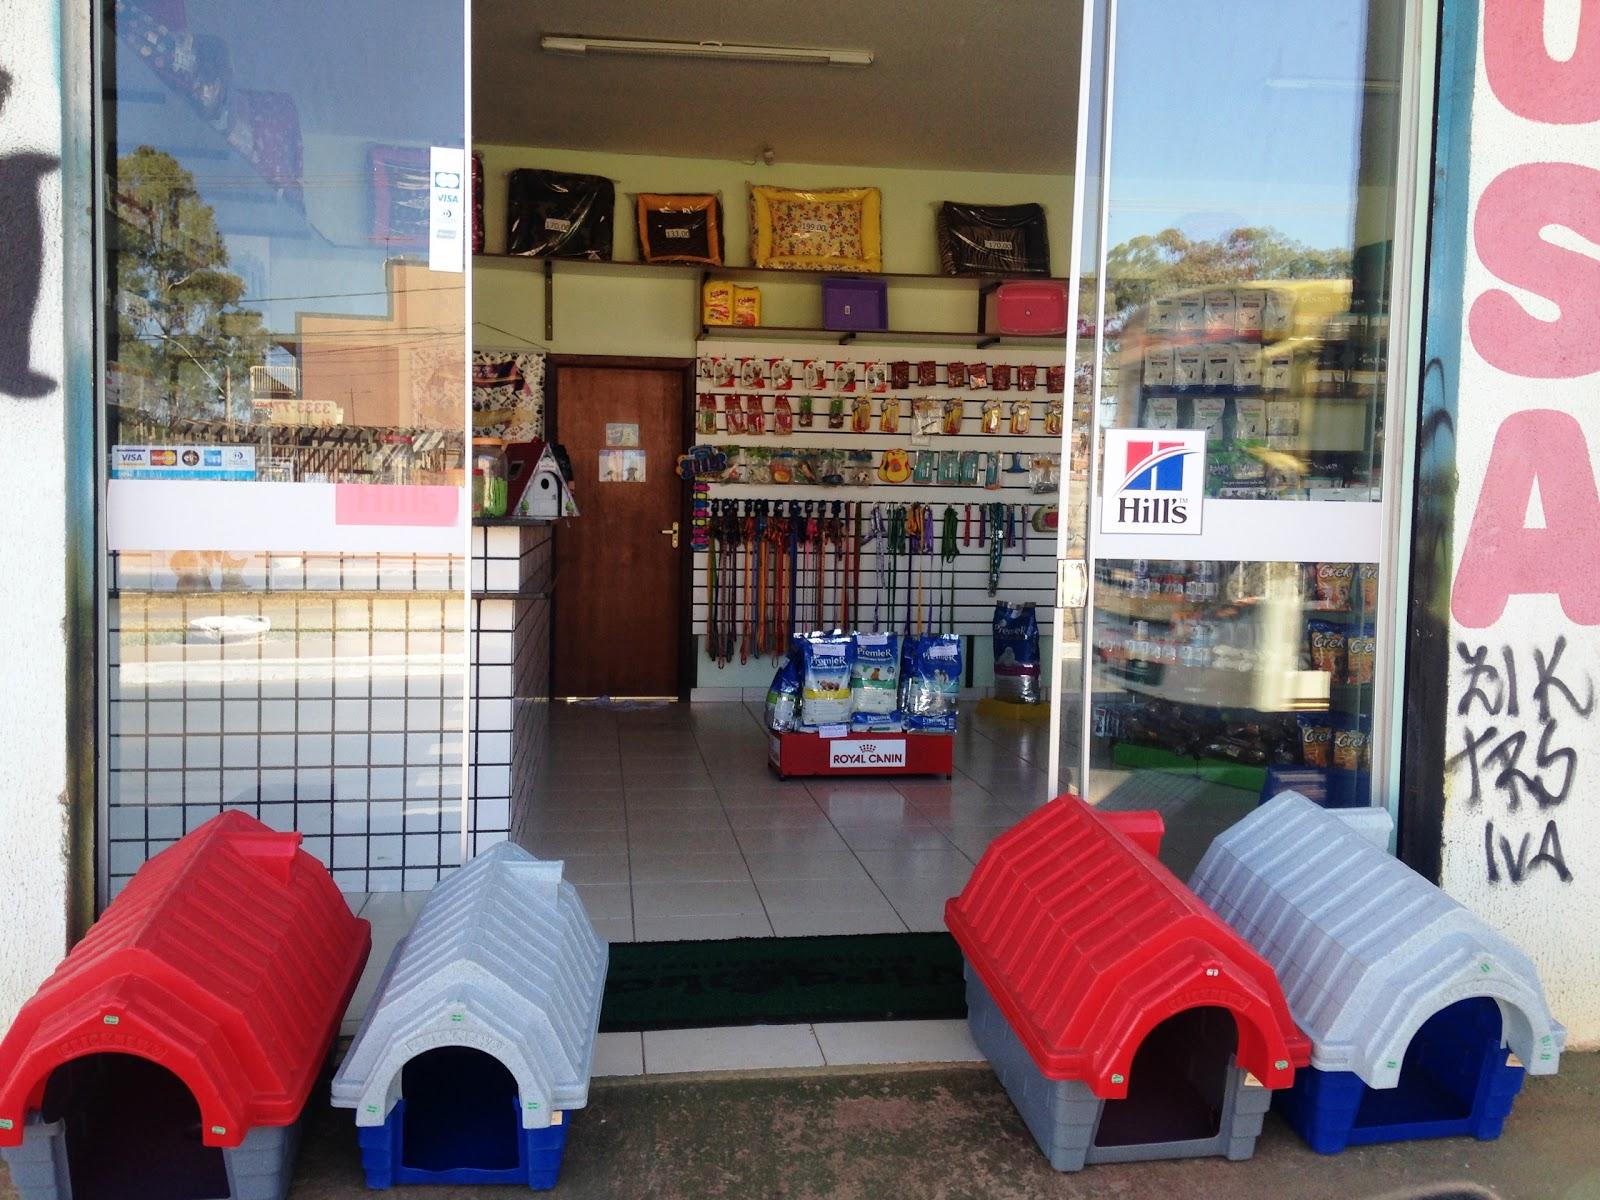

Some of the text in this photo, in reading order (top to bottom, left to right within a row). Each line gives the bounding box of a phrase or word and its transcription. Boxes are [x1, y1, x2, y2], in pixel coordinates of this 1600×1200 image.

[437, 194, 459, 203] VISA
[121, 453, 144, 462] VISA
[1117, 496, 1188, 525] Hill's
[833, 753, 902, 764] ROYAL CANIN
